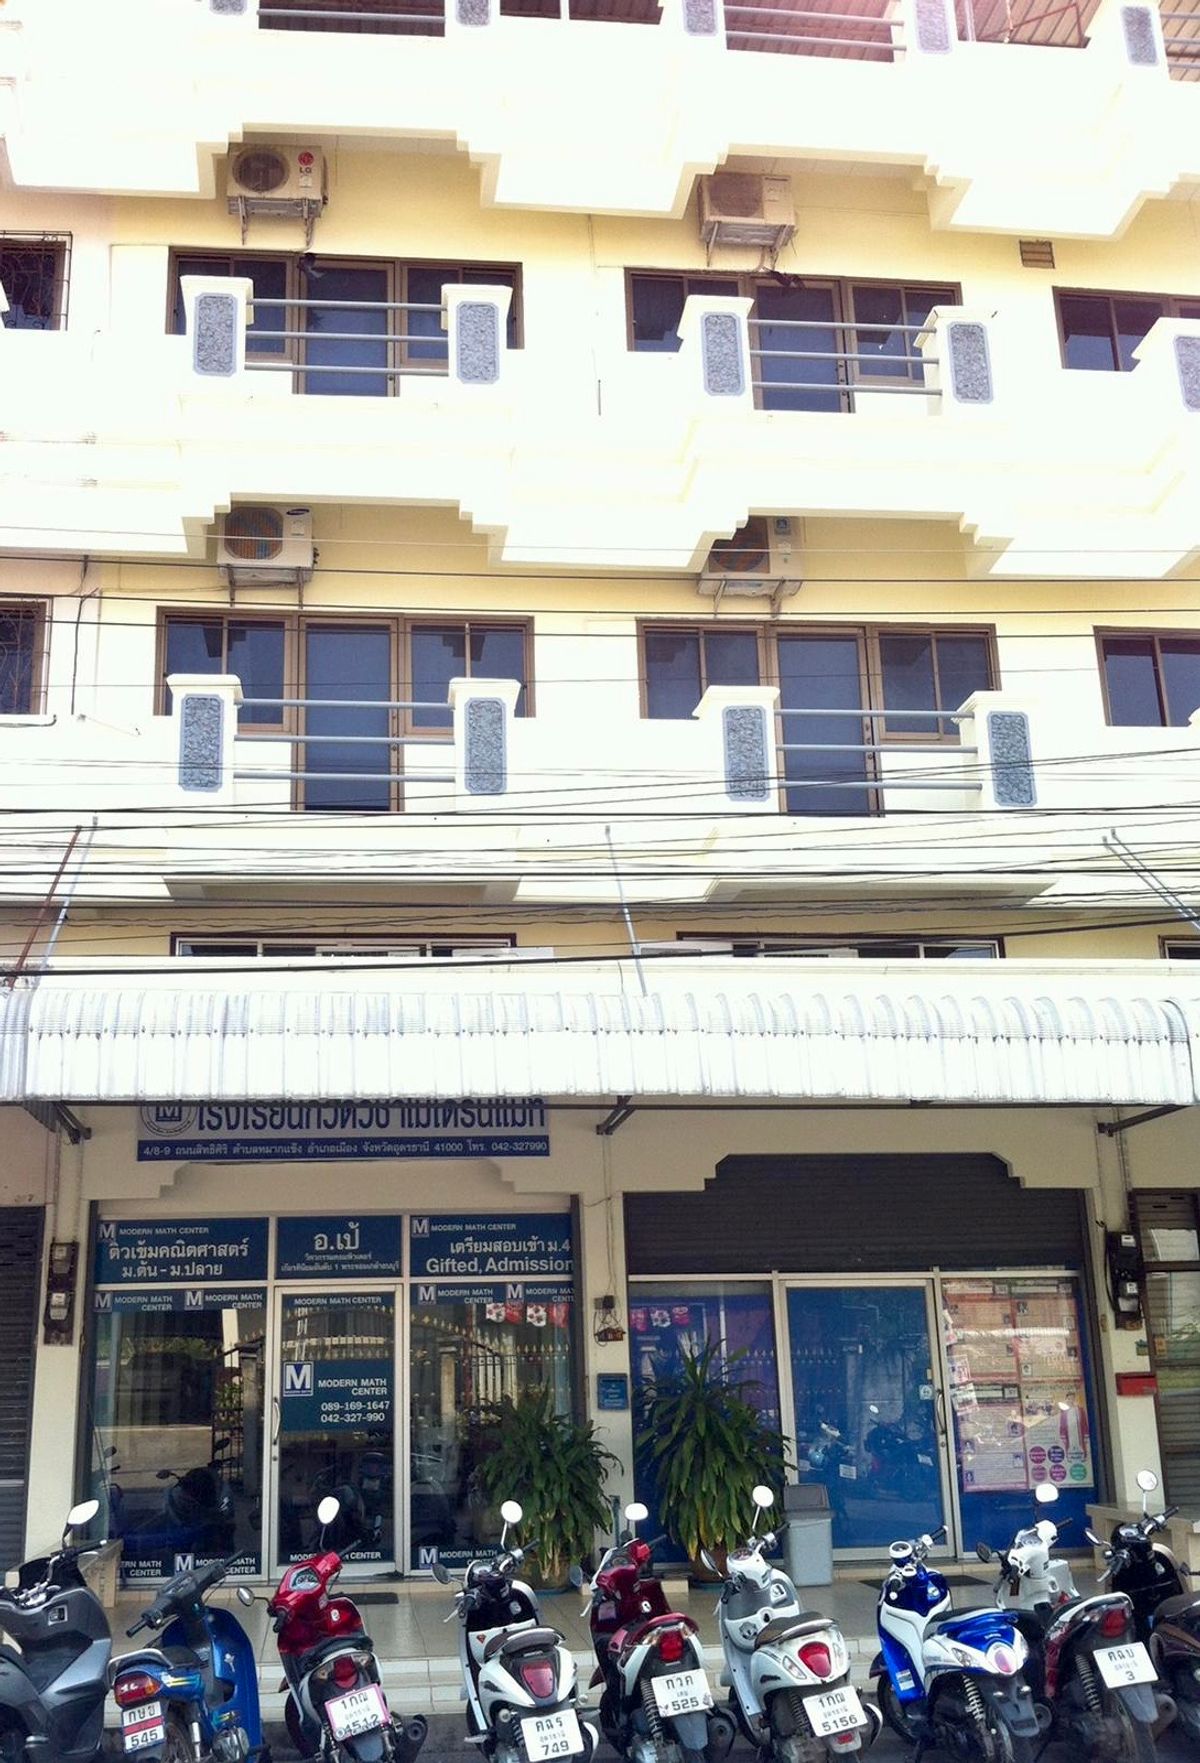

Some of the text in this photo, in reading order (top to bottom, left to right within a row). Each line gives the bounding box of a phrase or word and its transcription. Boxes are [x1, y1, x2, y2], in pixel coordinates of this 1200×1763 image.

[143, 1146, 171, 1156] 4/8-9
[434, 1141, 463, 1152] 41000
[491, 1140, 547, 1151] 042-327990
[99, 1223, 115, 1239] M
[119, 1226, 209, 1236] MODERN MATH CENTER
[412, 1219, 429, 1234] M
[430, 1222, 517, 1232] MODERN MATH CENTER
[314, 1221, 360, 1251] อ.เป้
[108, 1237, 250, 1260] ติวเข้มคณิตศาสตร์
[450, 1235, 545, 1254] เตรียมสอบเข้า
[122, 1260, 157, 1278] ม.ต้น
[170, 1261, 223, 1277] ม.ปลาย
[418, 1286, 435, 1301] M
[437, 1288, 494, 1297] MODERN MATH
[506, 1283, 523, 1299] M
[525, 1287, 558, 1295] MODERN
[95, 1292, 112, 1309] M
[114, 1295, 173, 1304] MODERN MATH
[185, 1290, 202, 1306] M
[204, 1293, 263, 1302] MODERN MATH
[294, 1295, 382, 1306] MODERN MATH CENTER
[463, 1296, 494, 1304] CENTER
[141, 1304, 173, 1312] CENTER
[231, 1301, 263, 1310] CENTER
[285, 1364, 311, 1390] M
[318, 1378, 387, 1388] MODERN MATH
[351, 1387, 388, 1396] CENTER
[321, 1400, 390, 1411] 089-169-1647
[320, 1412, 386, 1423] 042-327-990
[350, 1551, 382, 1560] CENTER
[420, 1548, 437, 1564] M
[439, 1549, 498, 1559] MODERN MATH
[139, 1560, 162, 1568] MATH
[176, 1554, 192, 1571] M
[129, 1568, 162, 1577] CENTER
[1125, 1670, 1136, 1681] 3
[671, 1696, 700, 1711] 525
[821, 1714, 858, 1732] 5156
[130, 1729, 158, 1747] 545
[541, 1739, 570, 1756] 749
